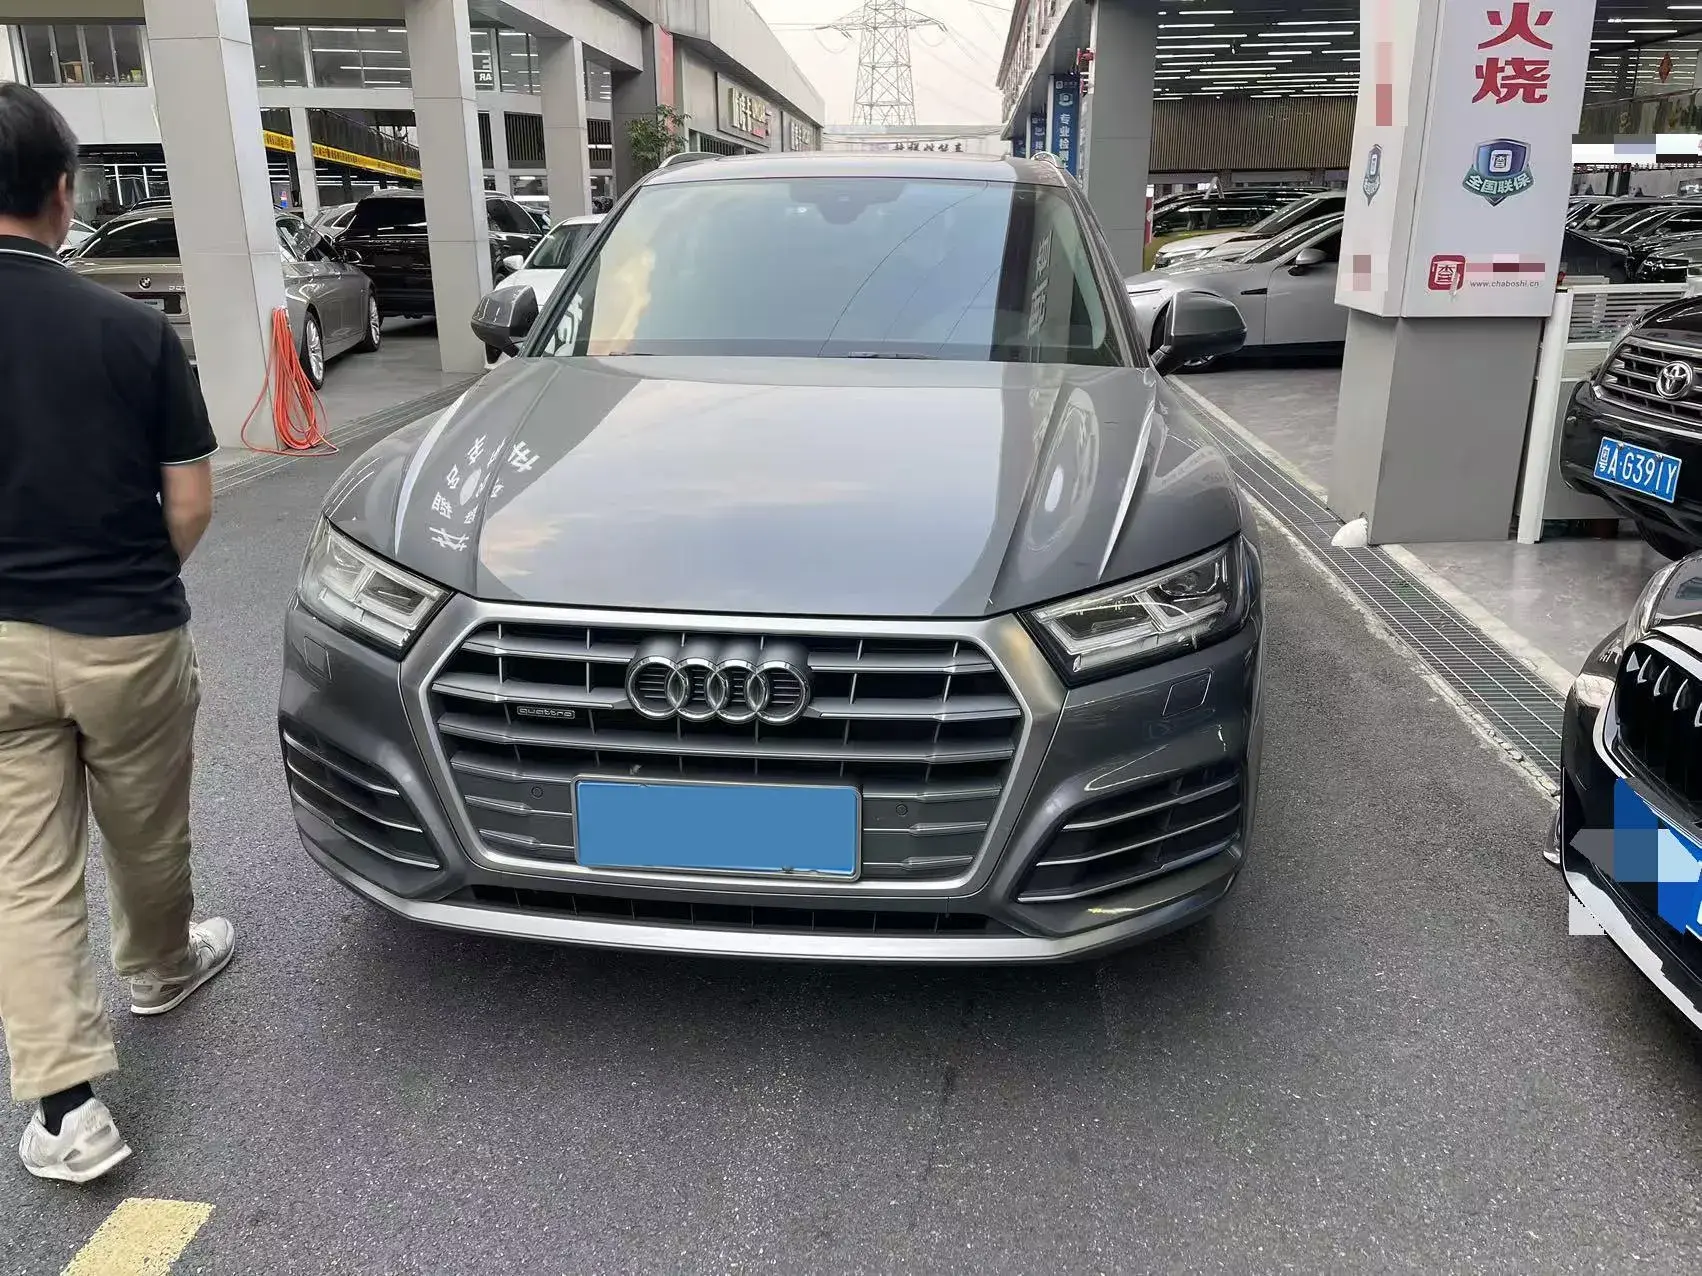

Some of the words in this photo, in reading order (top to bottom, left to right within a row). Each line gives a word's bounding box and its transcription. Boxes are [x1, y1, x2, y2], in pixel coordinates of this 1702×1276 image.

[1465, 173, 1531, 195] 全国联保
[1470, 280, 1540, 288] www.chaboshi.cn
[518, 707, 573, 718] quattro
